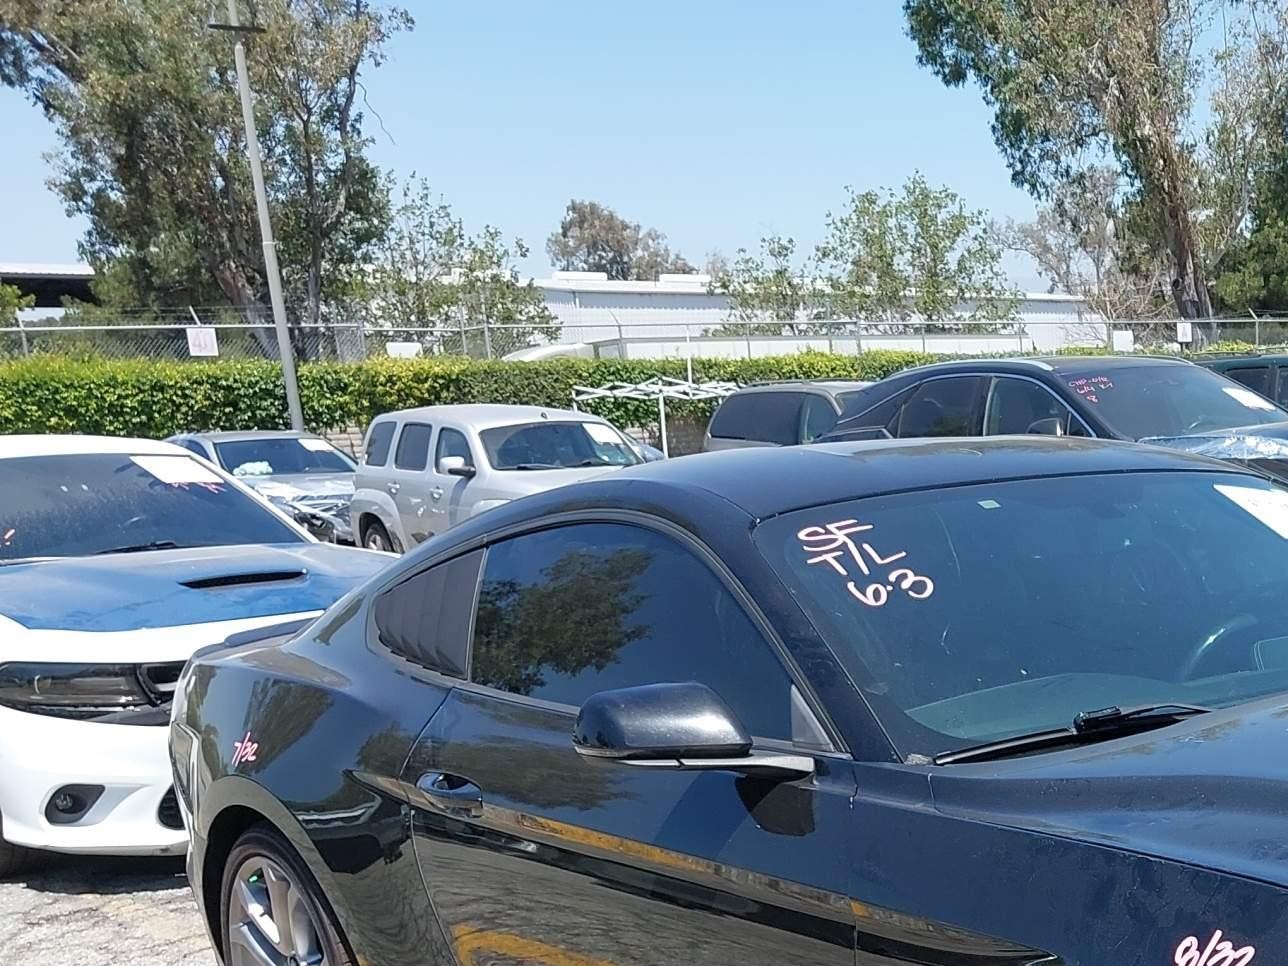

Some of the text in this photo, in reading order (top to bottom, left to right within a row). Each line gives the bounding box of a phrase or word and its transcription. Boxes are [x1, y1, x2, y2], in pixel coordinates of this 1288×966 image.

[797, 519, 874, 551] SF
[806, 540, 907, 576] T/L
[231, 731, 259, 767] 7/32
